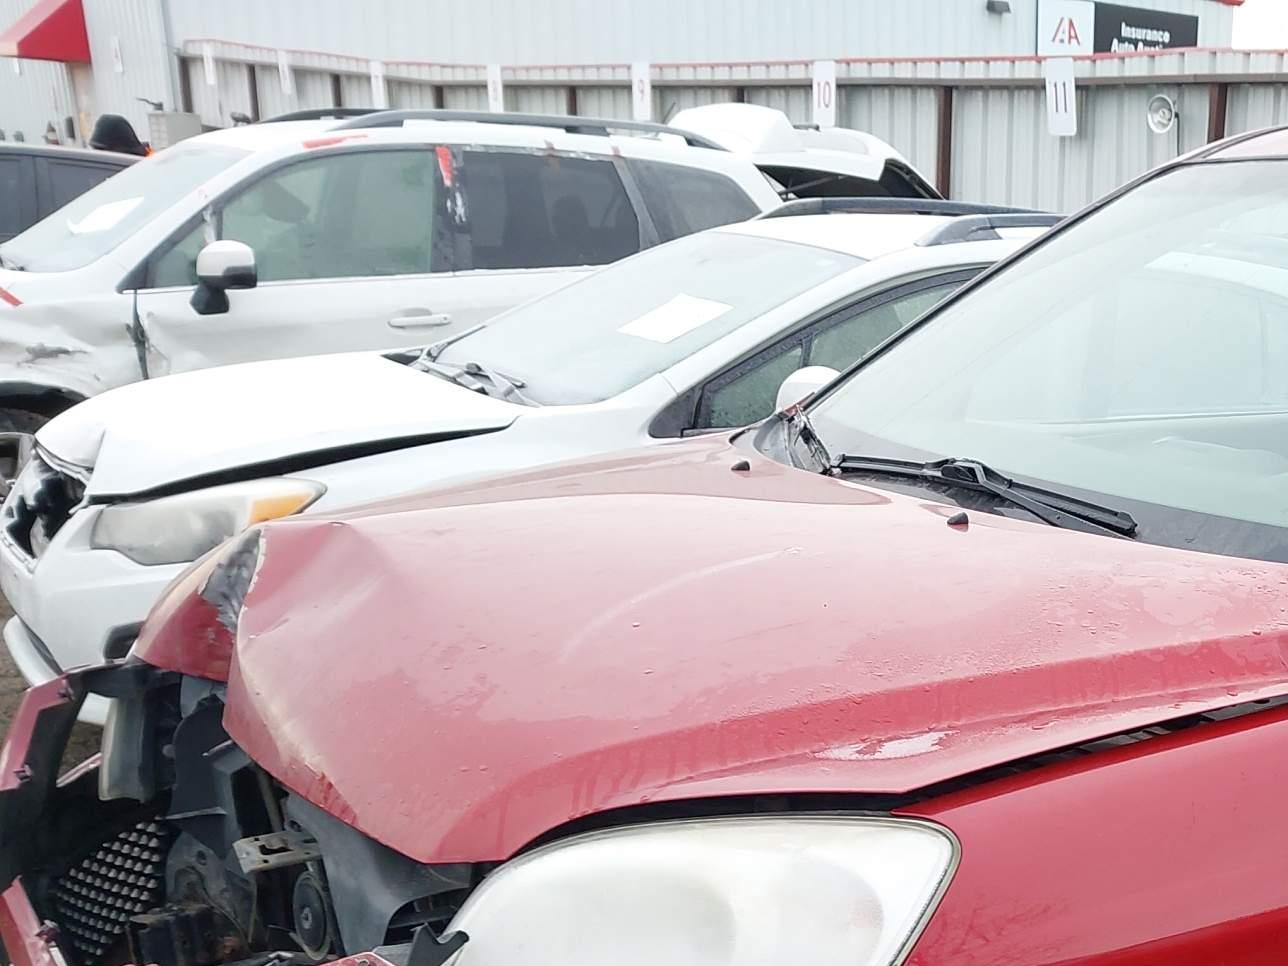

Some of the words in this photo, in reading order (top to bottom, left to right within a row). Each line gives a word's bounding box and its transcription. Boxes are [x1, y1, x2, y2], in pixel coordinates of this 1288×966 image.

[1120, 21, 1171, 43] Insurance
[817, 81, 832, 109] 10
[1054, 81, 1068, 113] 11
